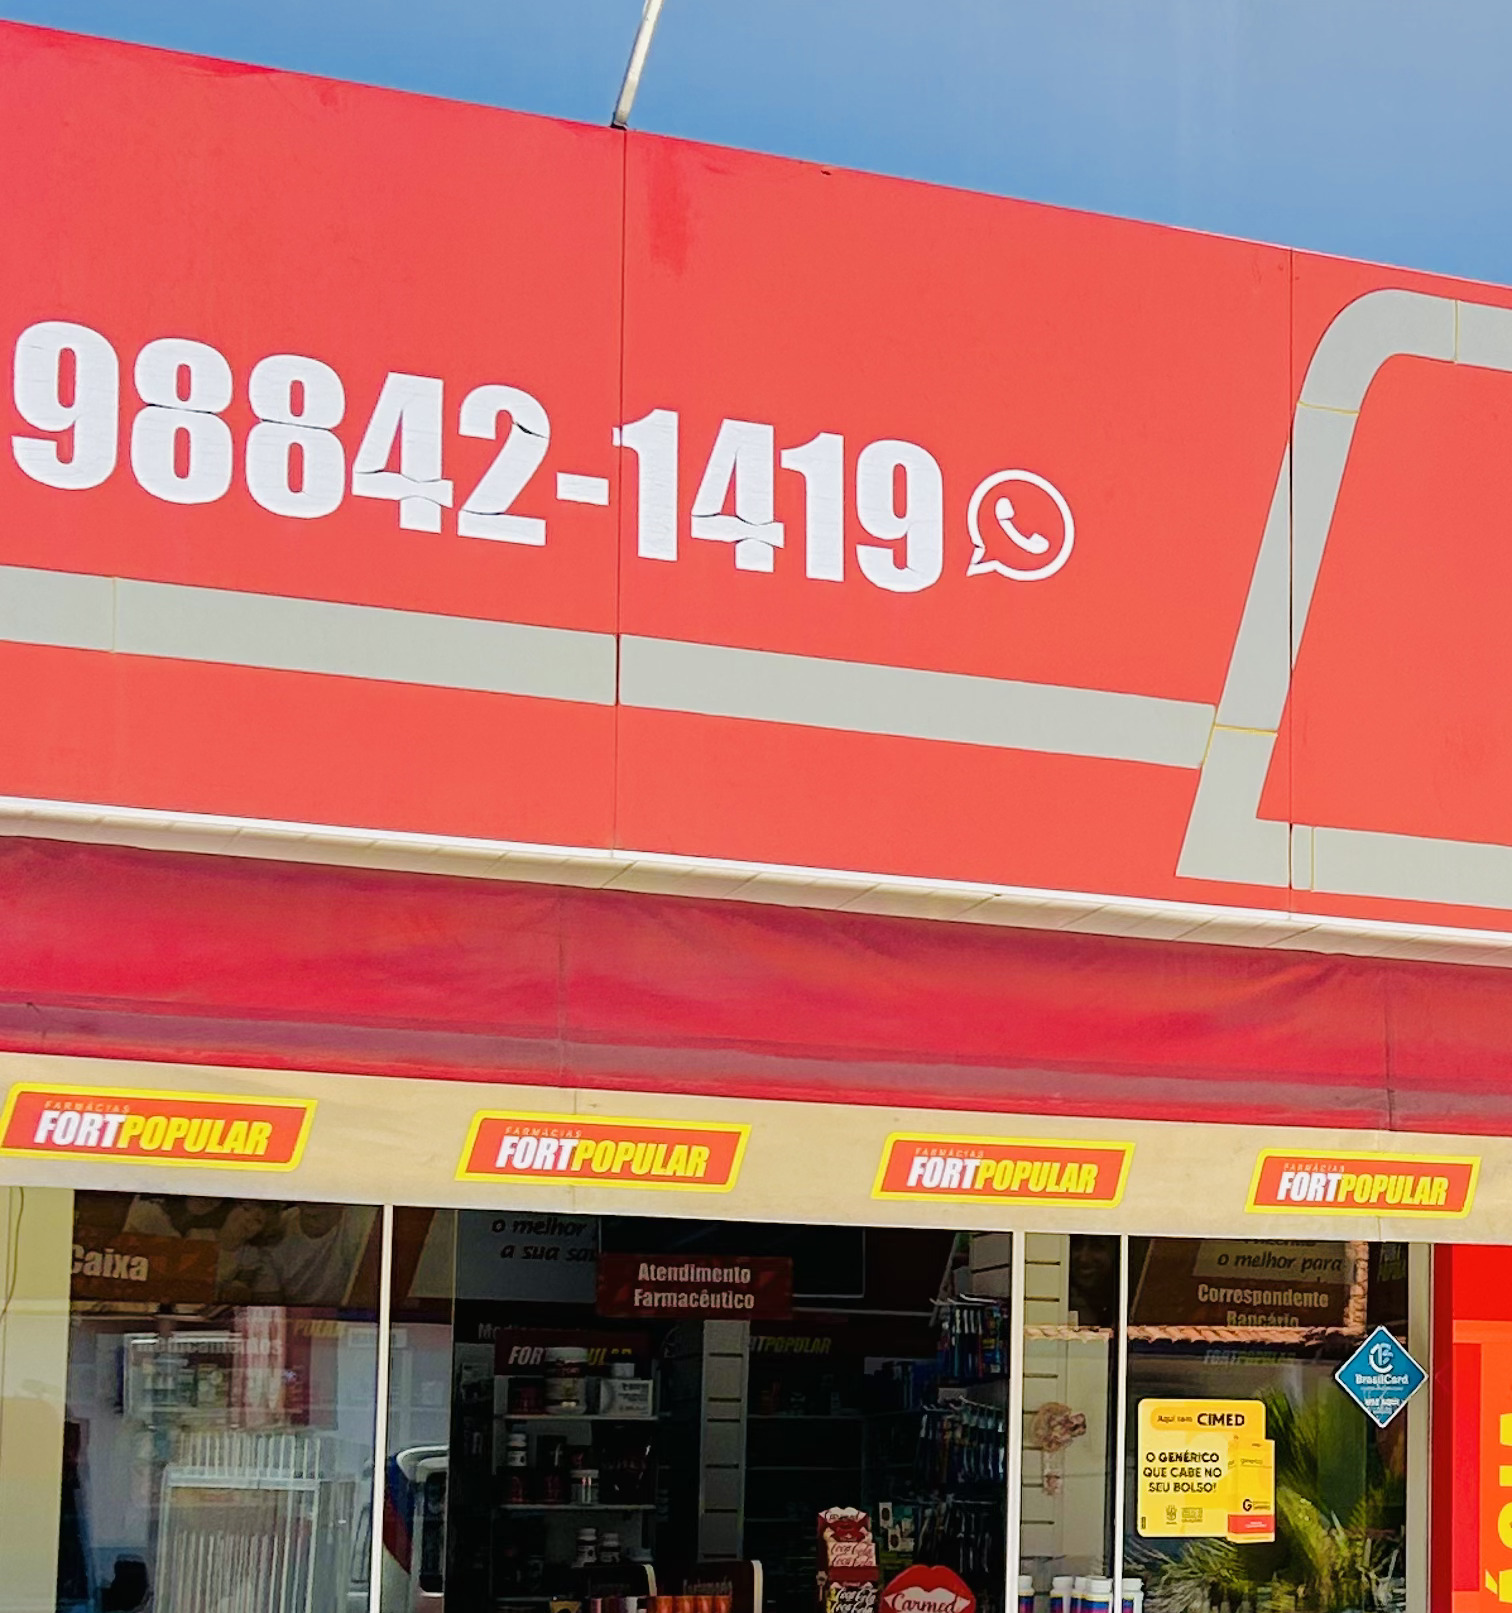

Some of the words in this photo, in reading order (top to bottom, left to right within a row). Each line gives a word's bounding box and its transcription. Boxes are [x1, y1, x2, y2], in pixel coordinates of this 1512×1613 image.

[12, 320, 944, 593] 98842-1419
[34, 1110, 273, 1155] FORTPOPULAR
[495, 1136, 710, 1178] FORTPOPULAR
[907, 1156, 1099, 1194] FORTPOPULAR
[1277, 1172, 1449, 1206] FORTPOPULAR
[512, 1217, 587, 1238] melhor
[71, 1244, 149, 1282] Caixa
[520, 1245, 559, 1262] sua
[1235, 1250, 1296, 1269] melhor
[1300, 1256, 1344, 1274] para
[637, 1262, 752, 1285] Atendimento
[633, 1287, 756, 1311] Farmacêutico
[1198, 1283, 1329, 1308] Correspondente
[1196, 1413, 1245, 1427] CIMED
[1145, 1452, 1156, 1463] O
[1158, 1449, 1220, 1463] GENÉRICO
[1143, 1467, 1169, 1478] QUE
[1170, 1467, 1202, 1478] CABE
[1204, 1467, 1222, 1478] NO
[1148, 1482, 1170, 1493] SEU
[1173, 1482, 1217, 1493] BOLSO!
[1242, 1498, 1253, 1512] G
